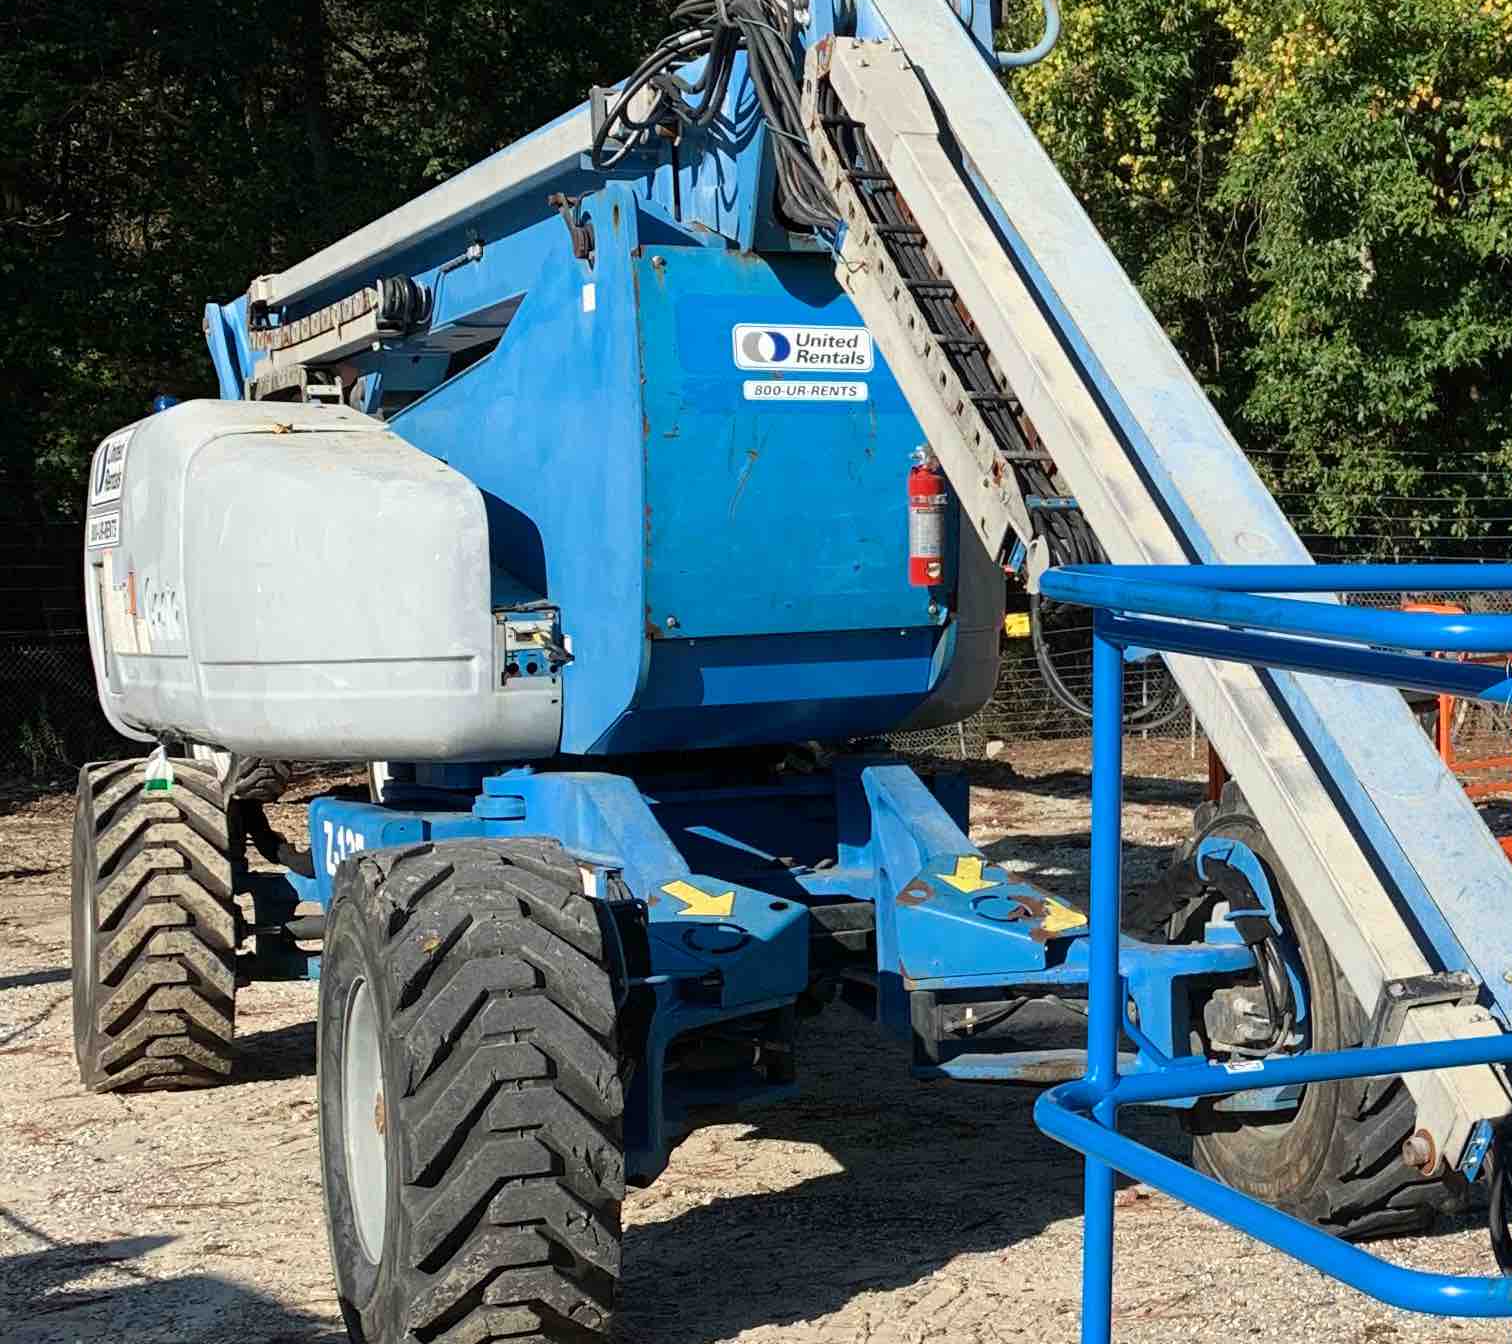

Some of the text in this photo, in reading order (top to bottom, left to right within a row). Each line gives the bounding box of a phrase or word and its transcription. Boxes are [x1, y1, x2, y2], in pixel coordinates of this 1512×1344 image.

[796, 333, 859, 348] United
[796, 349, 865, 365] Rentals
[754, 385, 857, 397] 800-UR-RENTS
